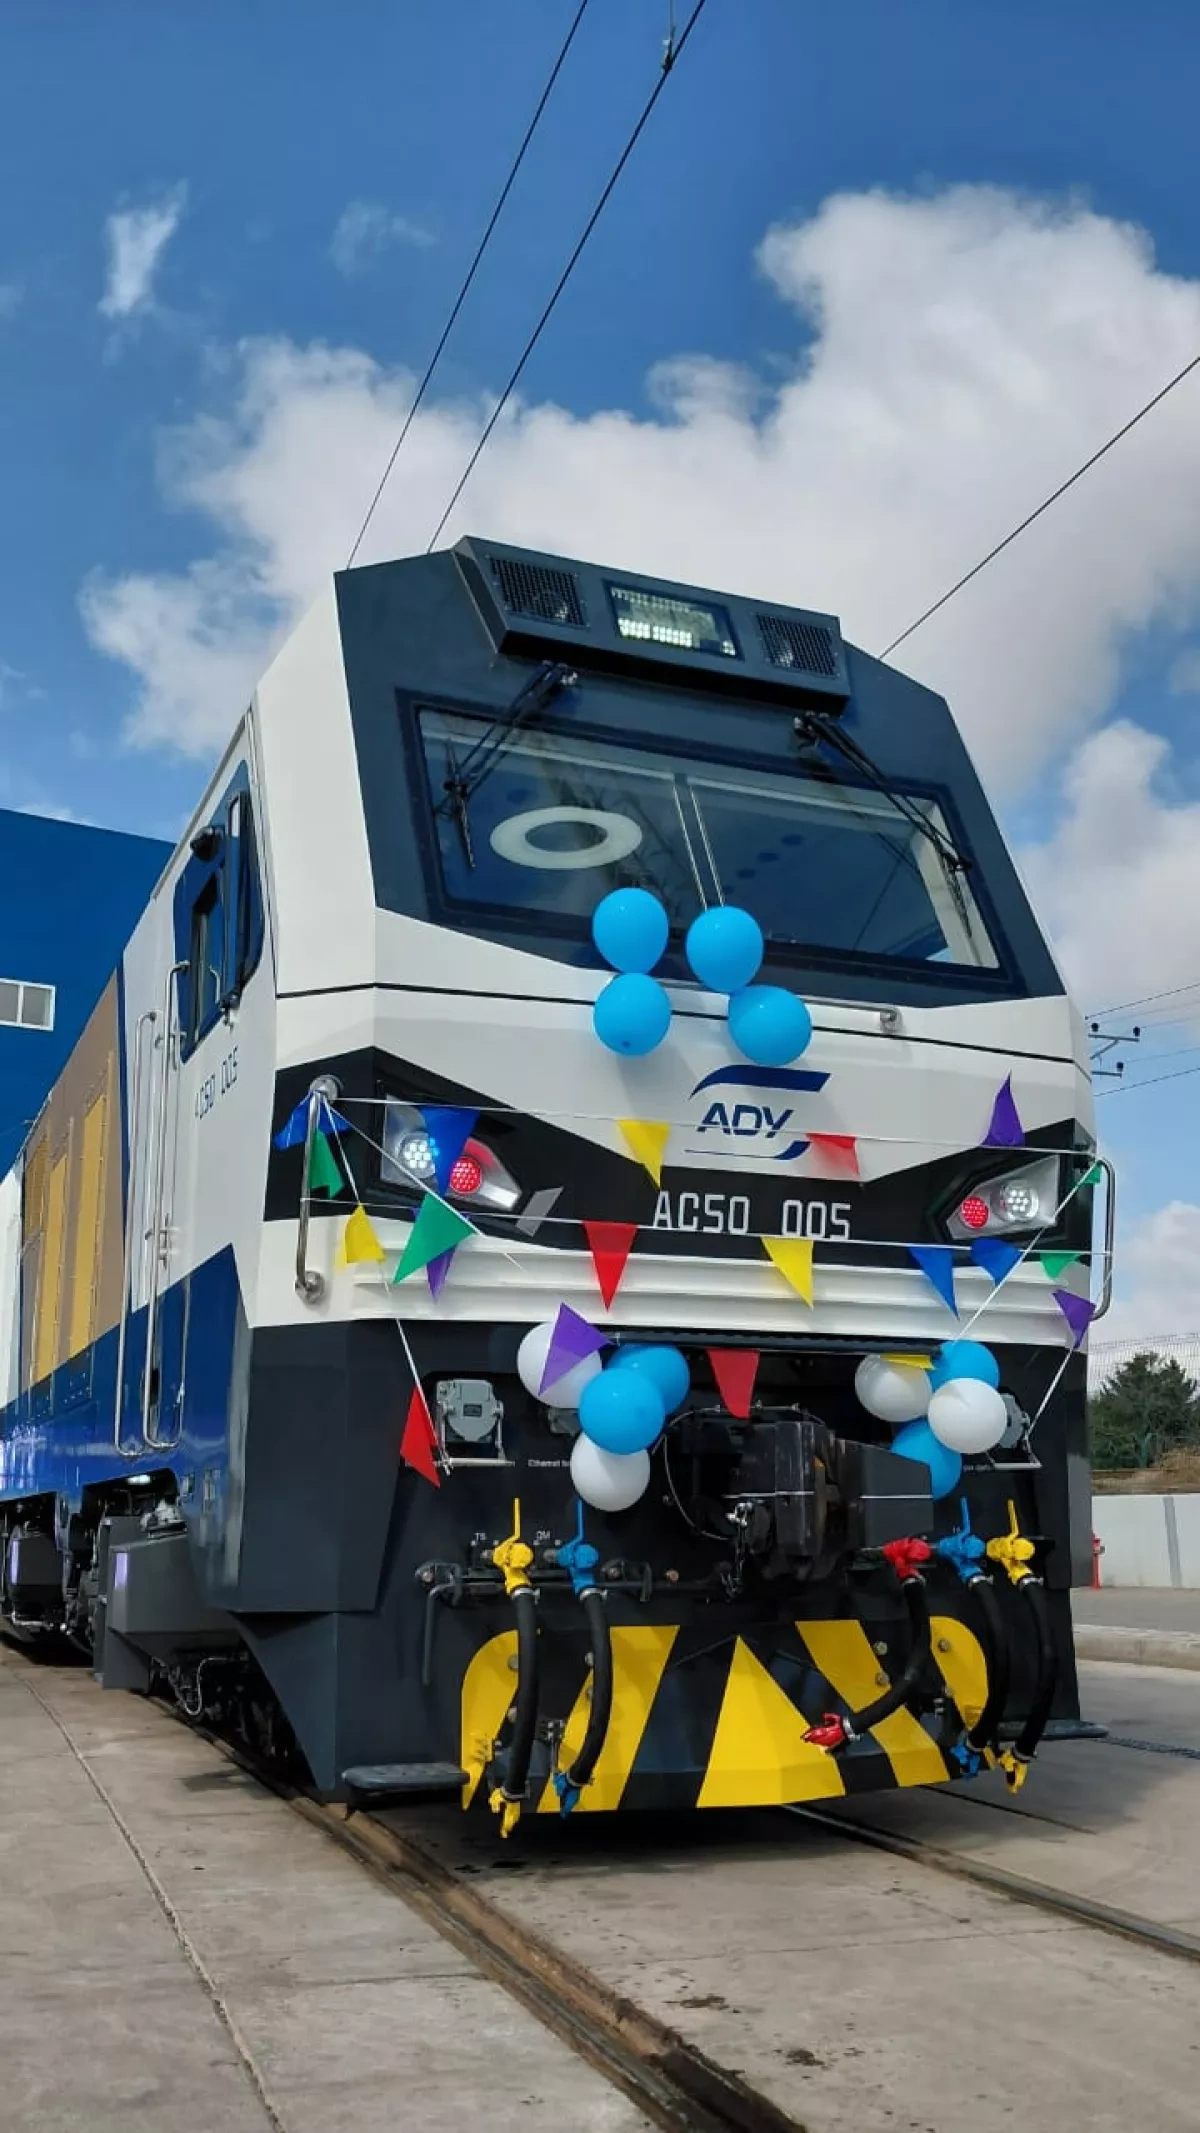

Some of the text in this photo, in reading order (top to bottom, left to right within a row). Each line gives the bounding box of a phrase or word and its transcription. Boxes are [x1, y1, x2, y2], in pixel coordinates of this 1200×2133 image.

[696, 1102, 794, 1138] ADY
[652, 1190, 852, 1241] AC50 005
